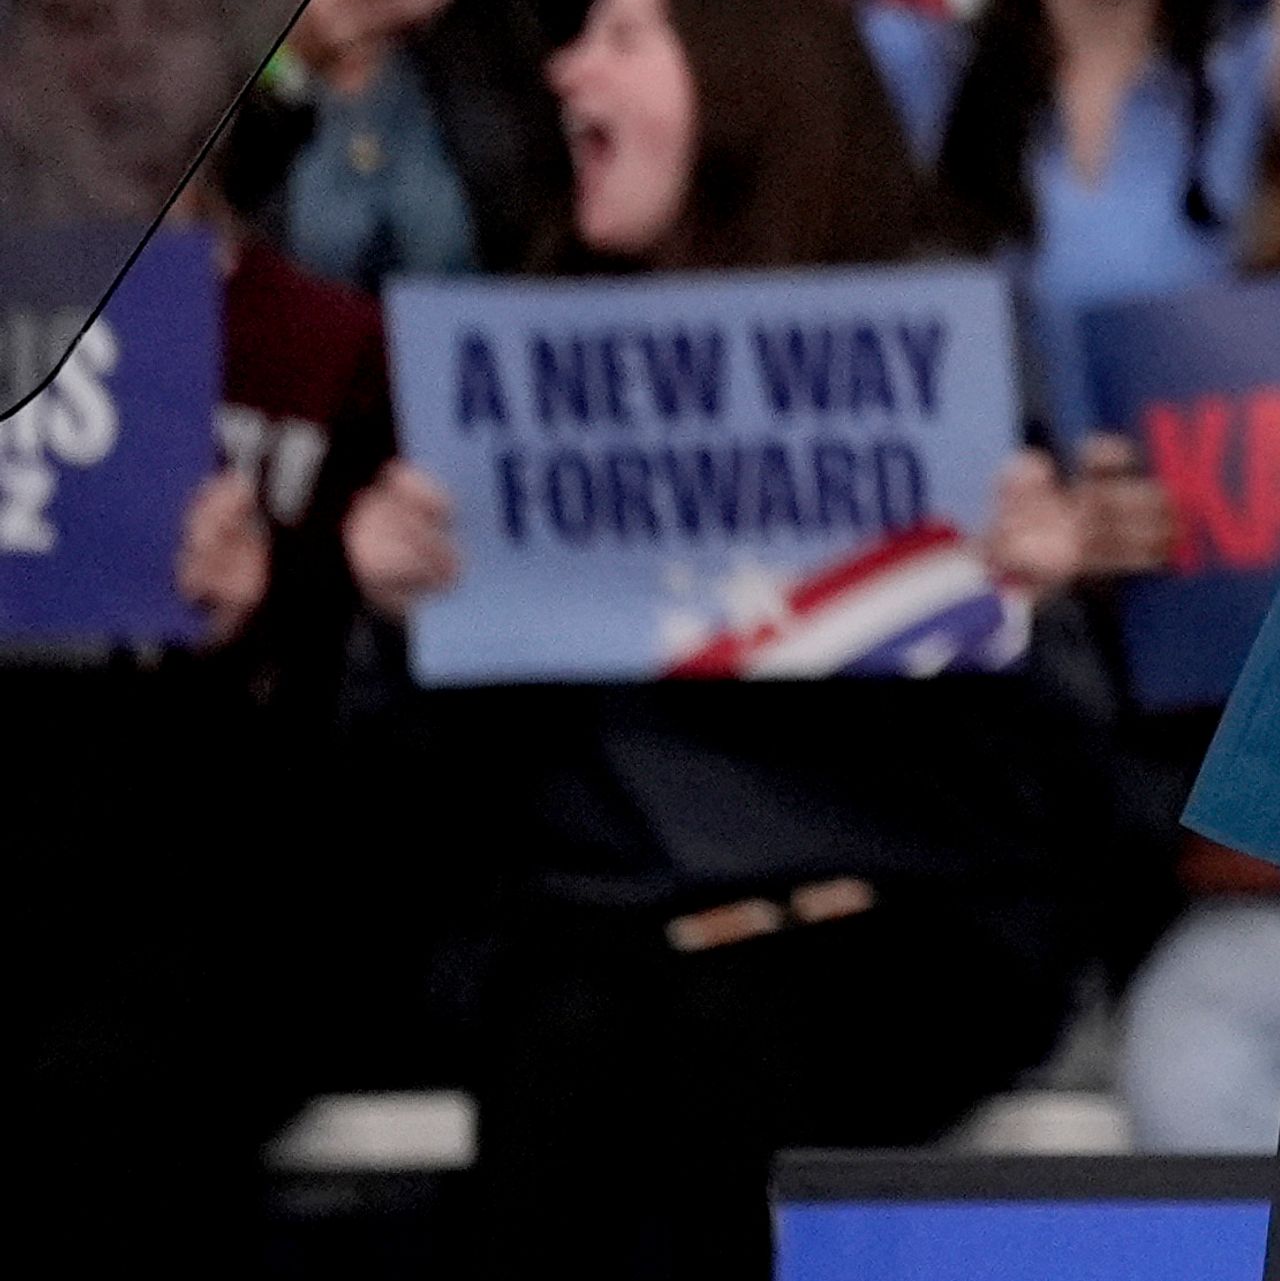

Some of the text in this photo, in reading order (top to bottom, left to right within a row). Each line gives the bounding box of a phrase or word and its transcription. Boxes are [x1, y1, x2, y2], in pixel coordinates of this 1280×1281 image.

[450, 313, 946, 438] A NEW WAY
[494, 434, 930, 544] FORWARD
